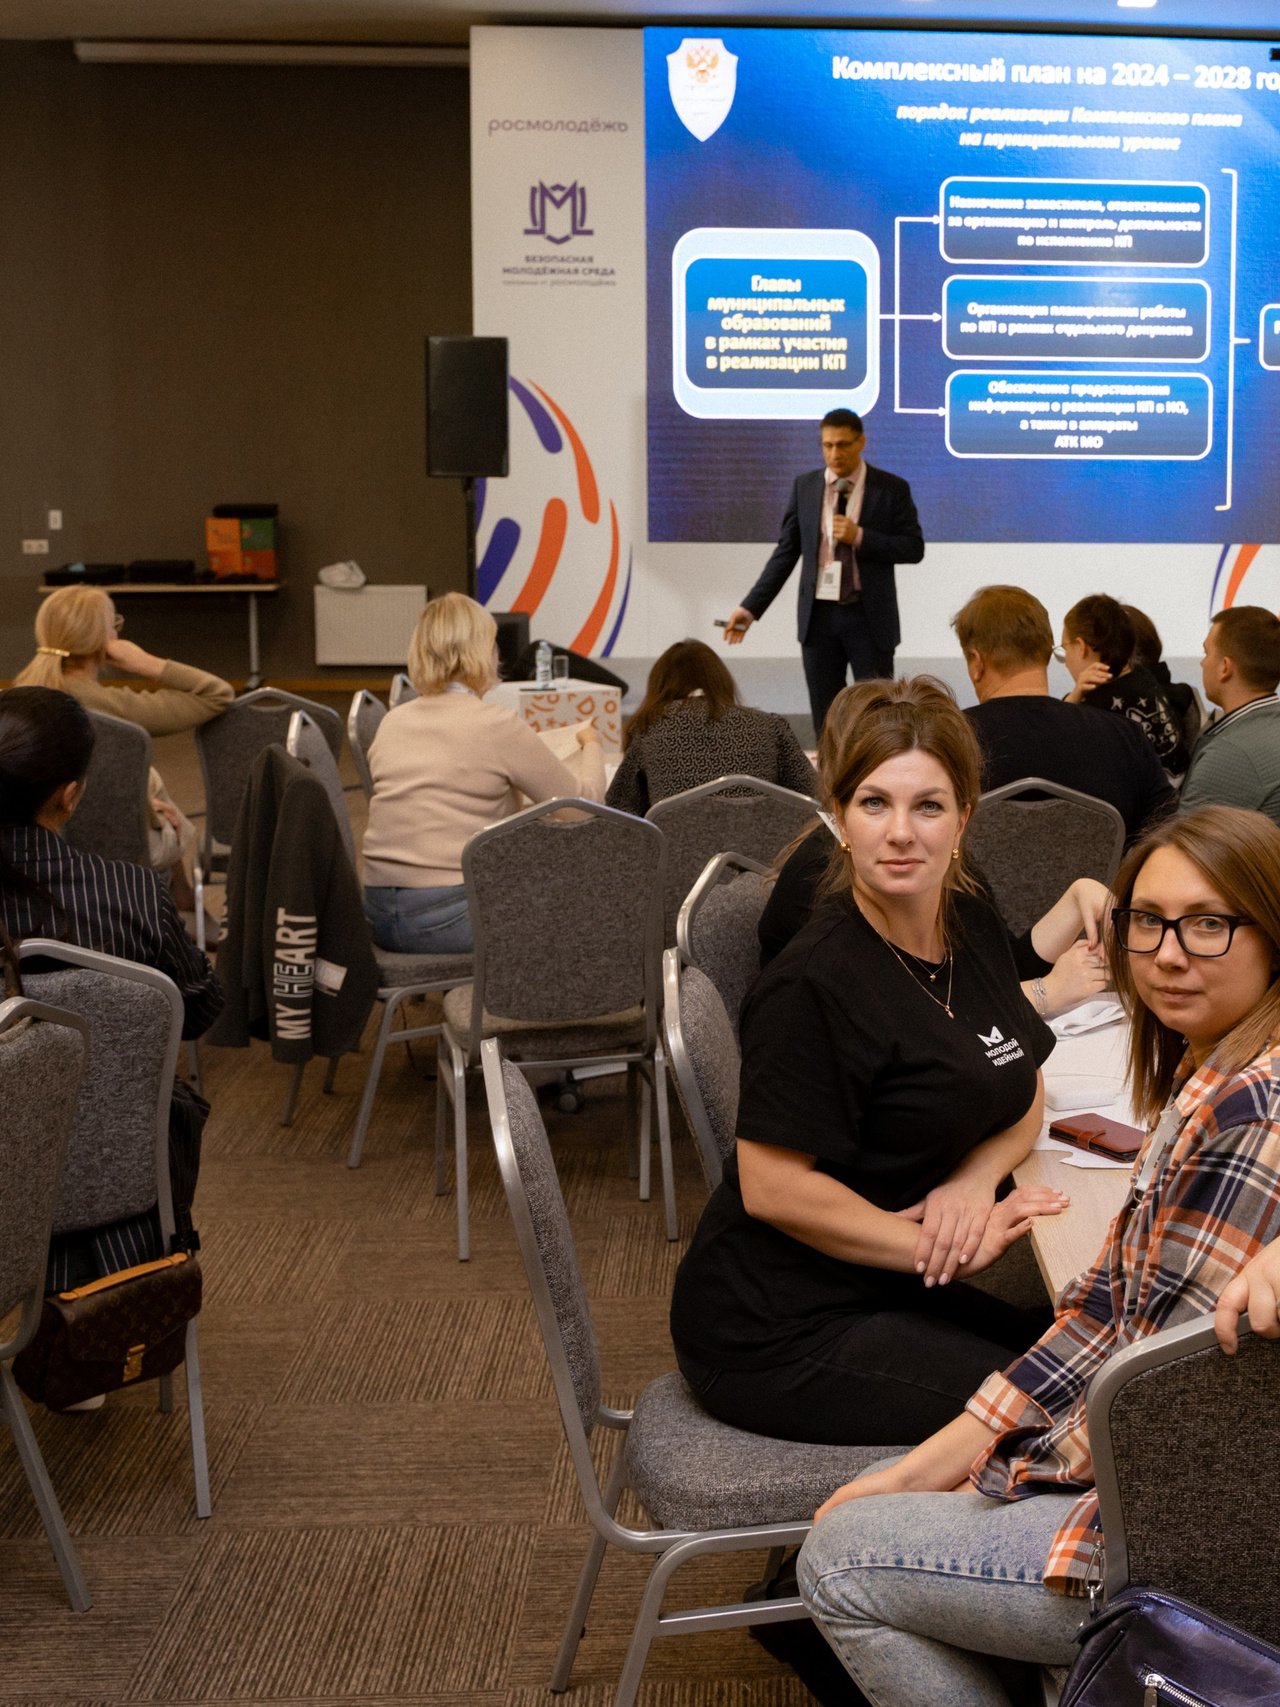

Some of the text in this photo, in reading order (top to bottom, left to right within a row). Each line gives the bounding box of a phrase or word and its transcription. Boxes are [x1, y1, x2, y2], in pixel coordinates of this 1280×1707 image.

[832, 56, 1006, 83] Комплексный
[1011, 64, 1072, 85] план
[1076, 66, 1107, 86] на
[1111, 62, 1170, 87] 2024
[1193, 64, 1252, 90] 2028
[896, 102, 1243, 127] порядок реализации Комплексного плана
[959, 132, 1182, 153] на муниципальном уровне
[751, 274, 802, 293] Главы
[707, 297, 846, 316] муниципальных
[720, 312, 832, 334] образований
[704, 335, 848, 355] в рамках участия
[705, 353, 847, 374] в реализации КП
[273, 907, 317, 1040] MY HEART
[985, 1038, 1019, 1058] МОЛОДОЙ
[992, 1048, 1025, 1067] ИДЕЙНЫЙ
